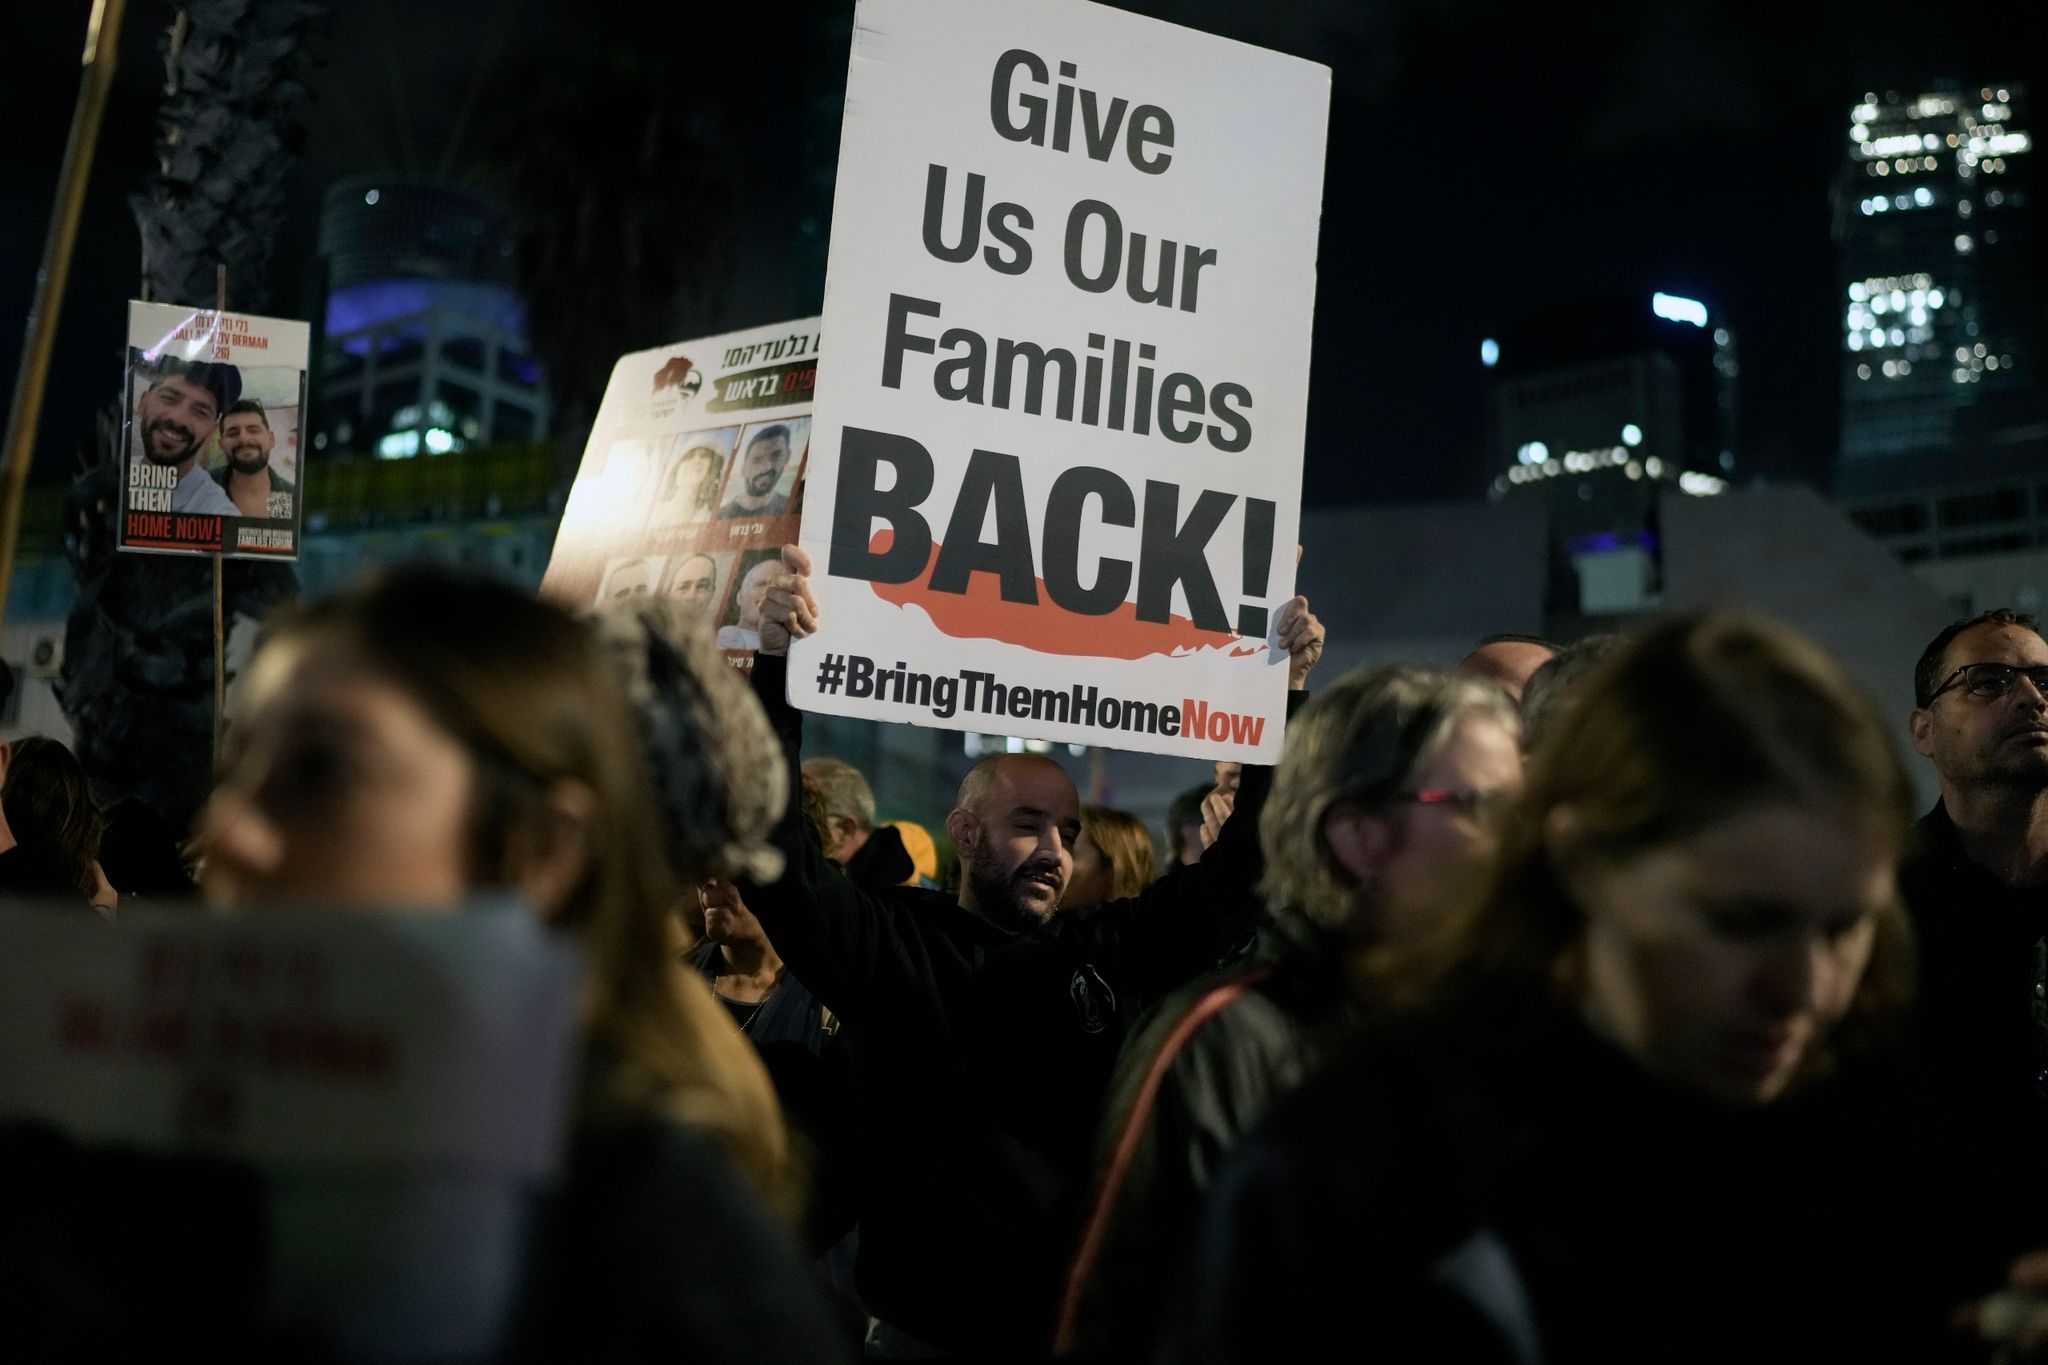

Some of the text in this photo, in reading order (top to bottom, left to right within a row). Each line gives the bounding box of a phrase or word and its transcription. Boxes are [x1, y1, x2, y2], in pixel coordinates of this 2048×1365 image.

[989, 48, 1177, 176] Give
[922, 163, 1218, 314] Us Our
[232, 333, 268, 350] BERMAN
[721, 334, 809, 369] בלעדיהם!
[724, 374, 780, 402] בראש
[881, 292, 1253, 454] Families
[129, 463, 177, 489] BRING
[129, 487, 172, 512] THEM
[127, 514, 172, 538] HOME
[176, 516, 222, 542] NOW!
[827, 425, 1277, 640] BACK!
[815, 653, 1266, 747] #BringThemHomeNow
